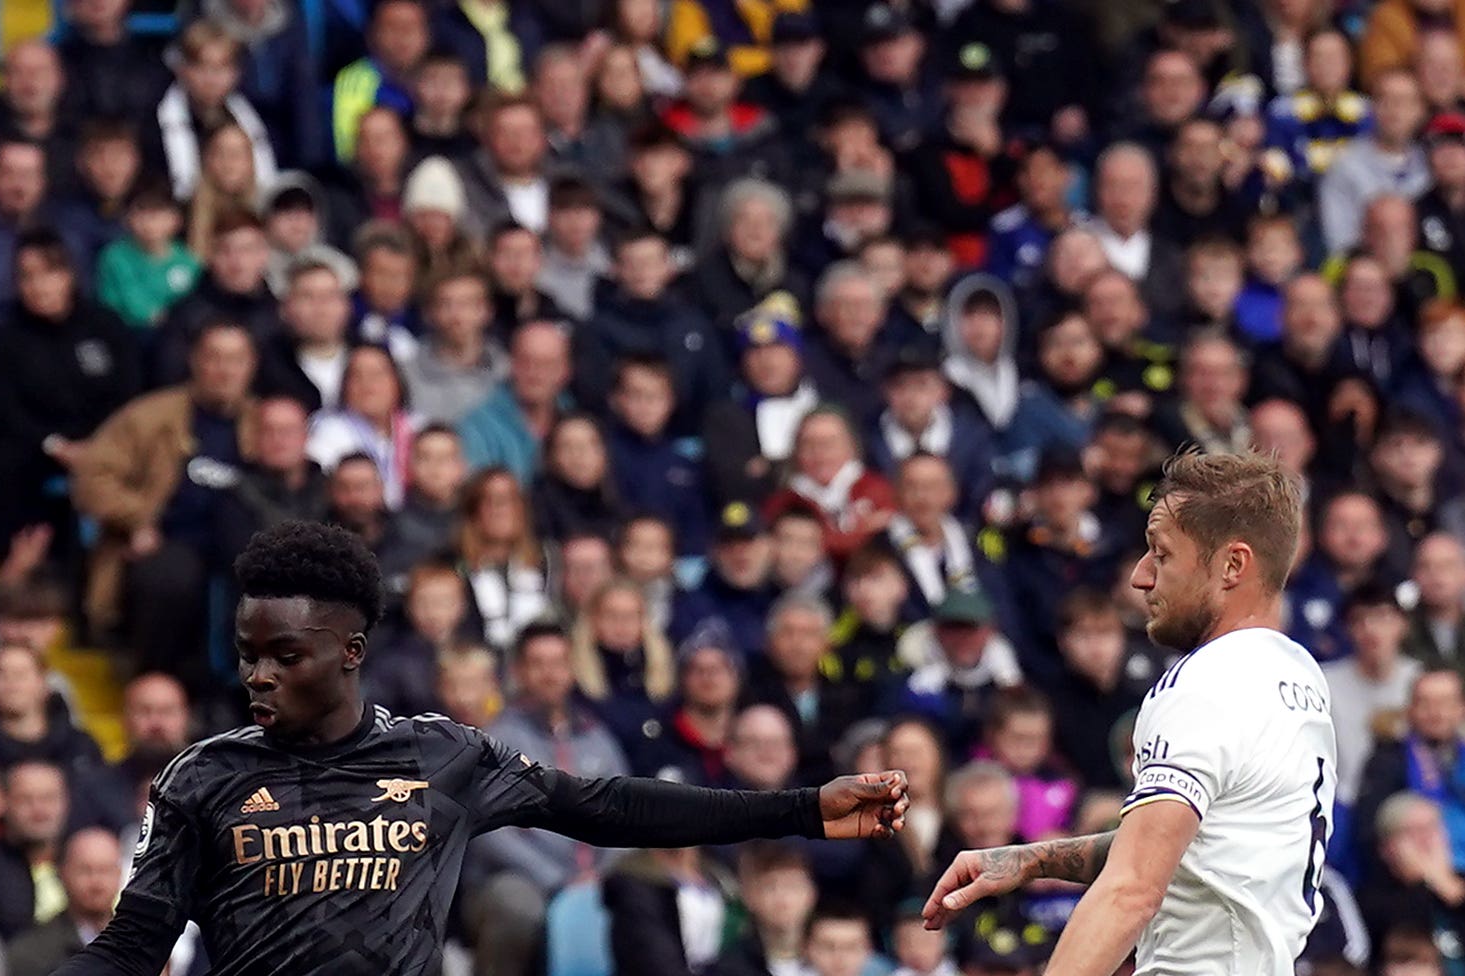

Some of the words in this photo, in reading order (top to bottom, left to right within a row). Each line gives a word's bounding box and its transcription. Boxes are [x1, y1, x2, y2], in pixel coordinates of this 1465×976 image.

[1278, 680, 1327, 713] COO
[240, 801, 280, 814] adidas
[232, 814, 428, 864] Emirates
[264, 862, 304, 897] FLY
[312, 857, 402, 893] BETTER
